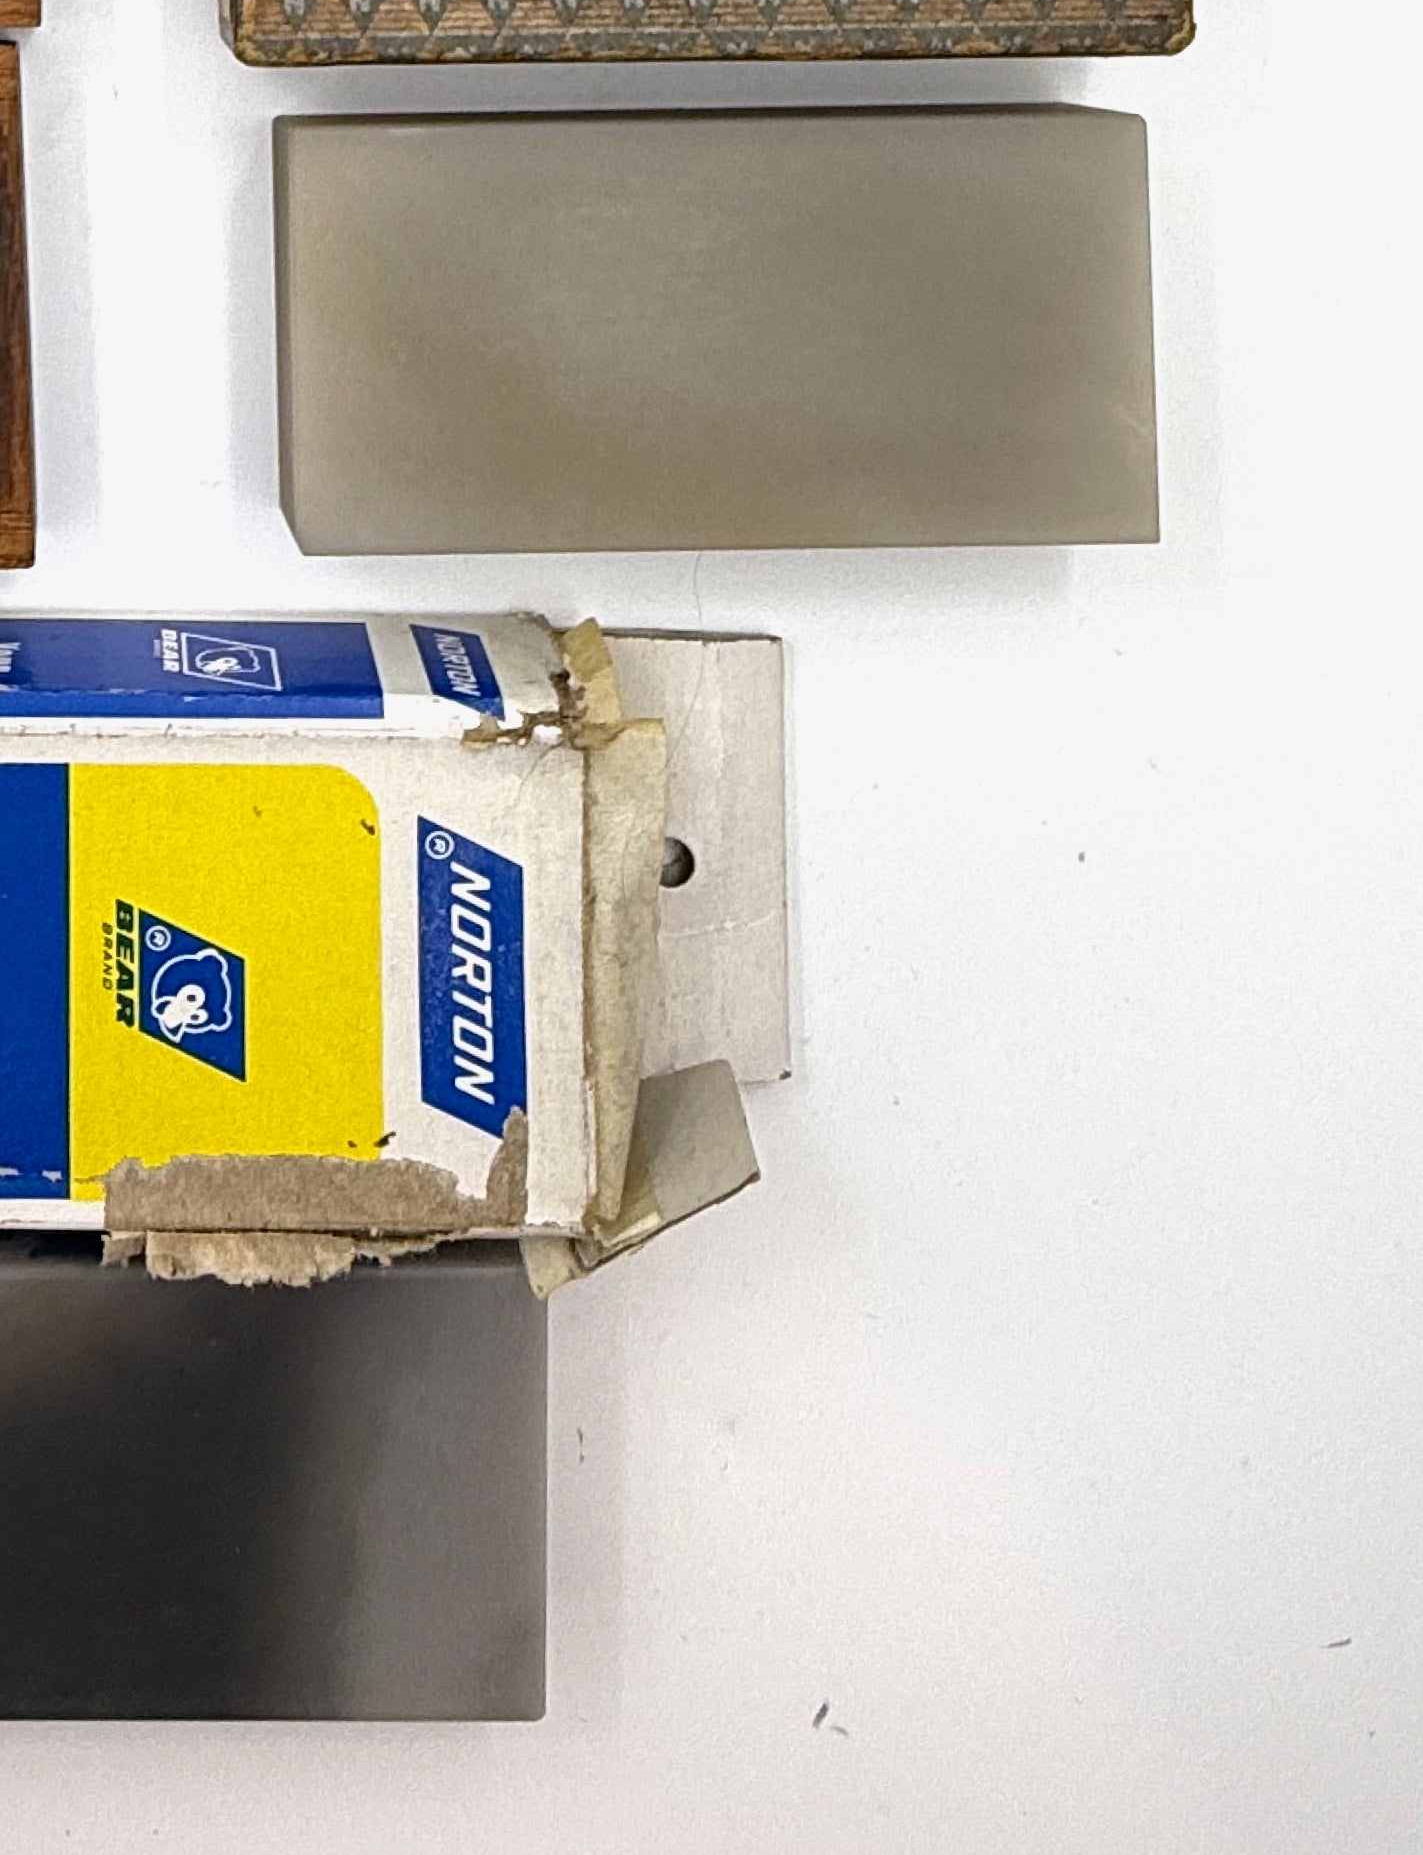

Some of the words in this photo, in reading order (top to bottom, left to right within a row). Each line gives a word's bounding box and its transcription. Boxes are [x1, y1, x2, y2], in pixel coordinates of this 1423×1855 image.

[432, 632, 482, 697] NORTON
[101, 922, 114, 992] BRAND
[115, 899, 135, 1029] BEAR
[451, 861, 495, 1107] NORTON
